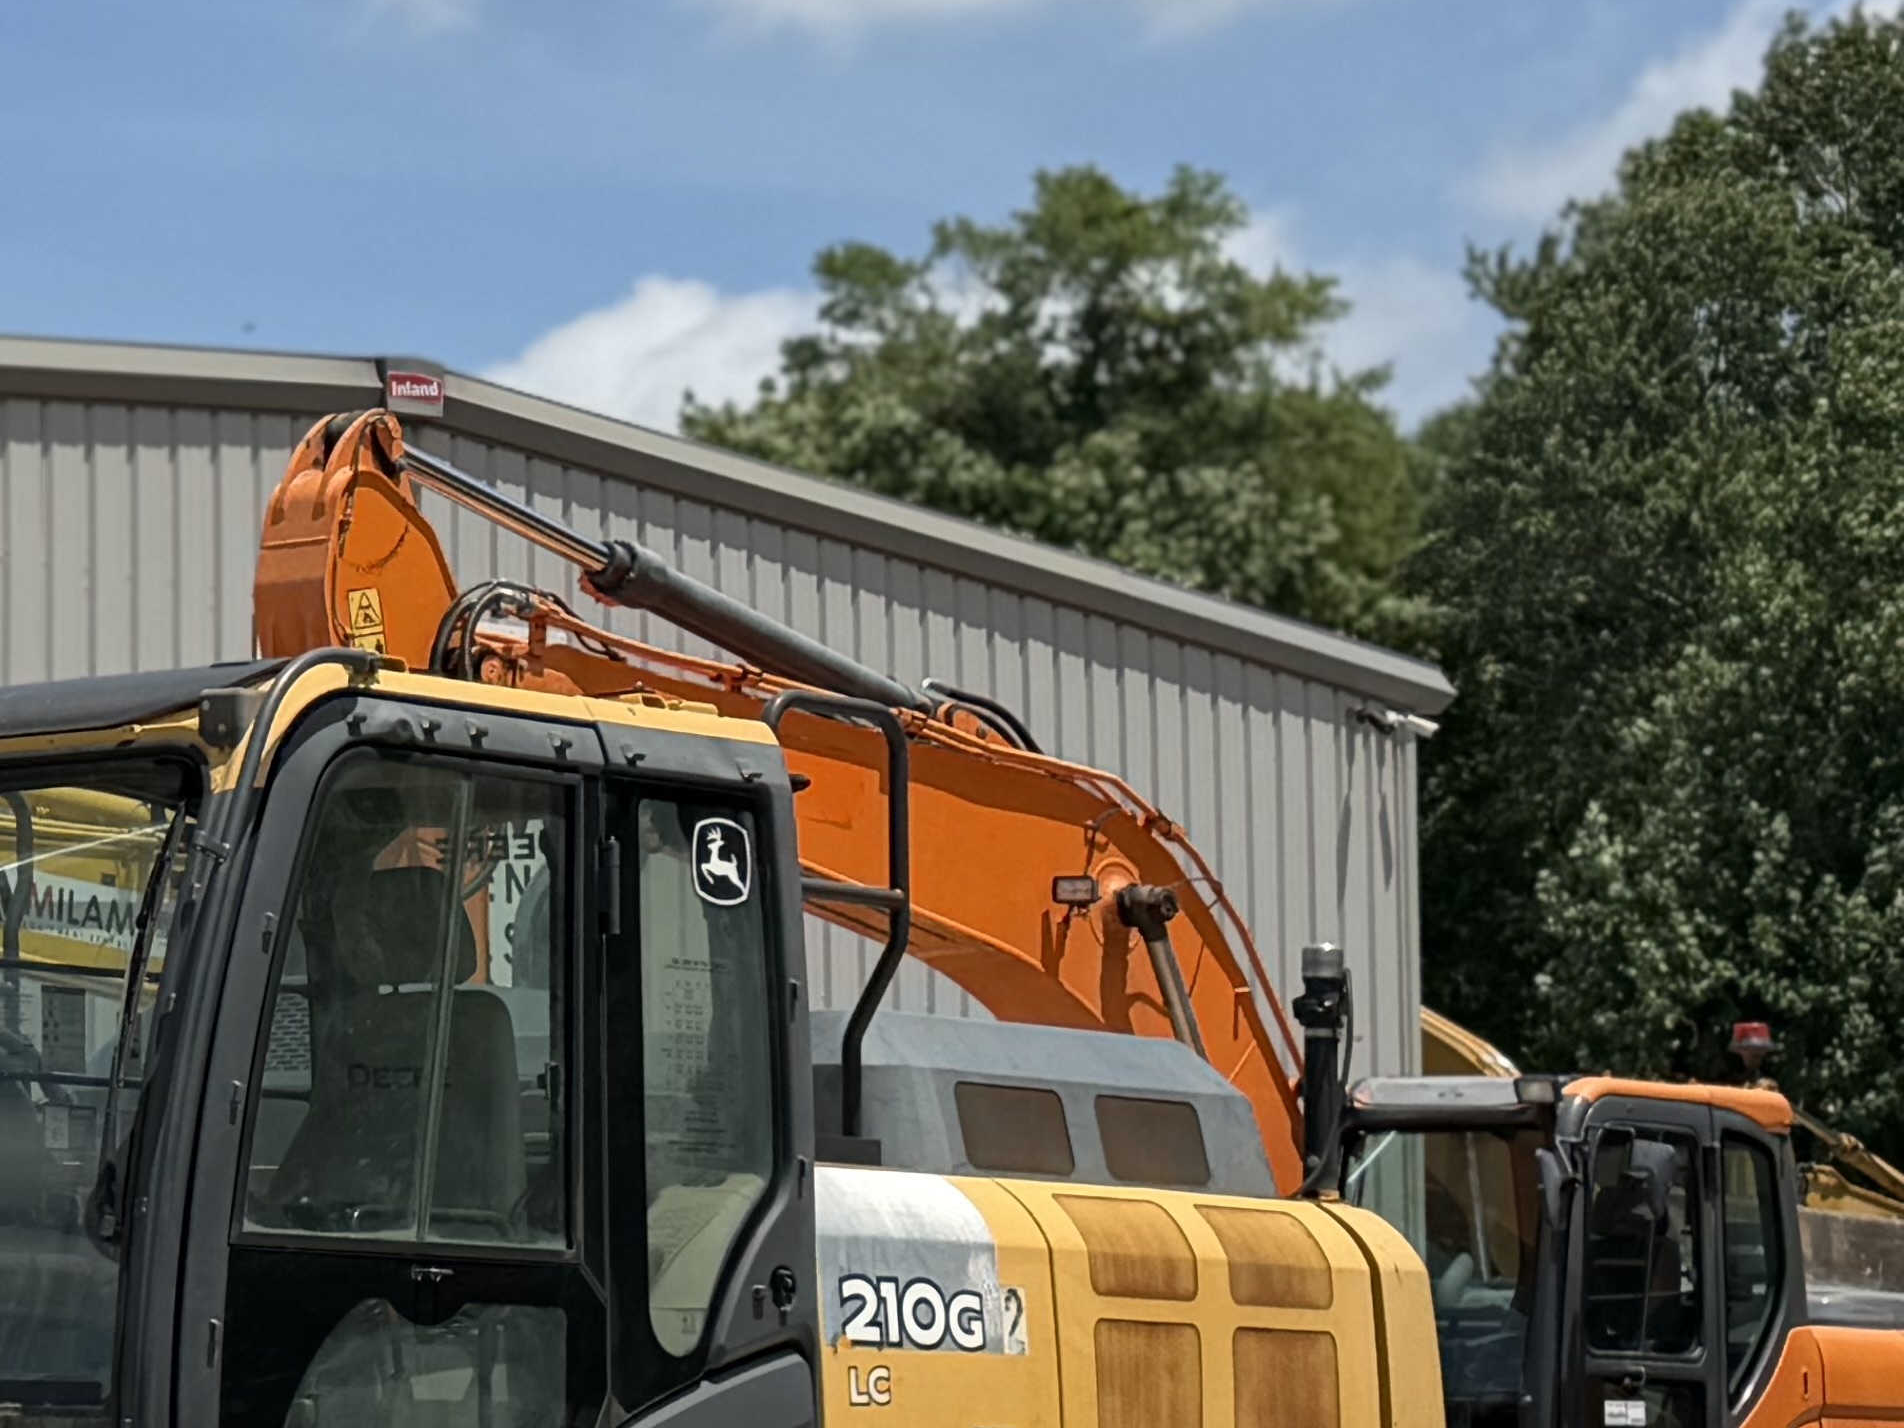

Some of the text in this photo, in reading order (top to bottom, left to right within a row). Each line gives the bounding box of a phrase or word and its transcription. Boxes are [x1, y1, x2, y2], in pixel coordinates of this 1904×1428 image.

[391, 379, 439, 398] Inland
[24, 882, 135, 936] MILAM
[839, 1273, 986, 1351] 210G
[848, 1365, 891, 1407] LC
